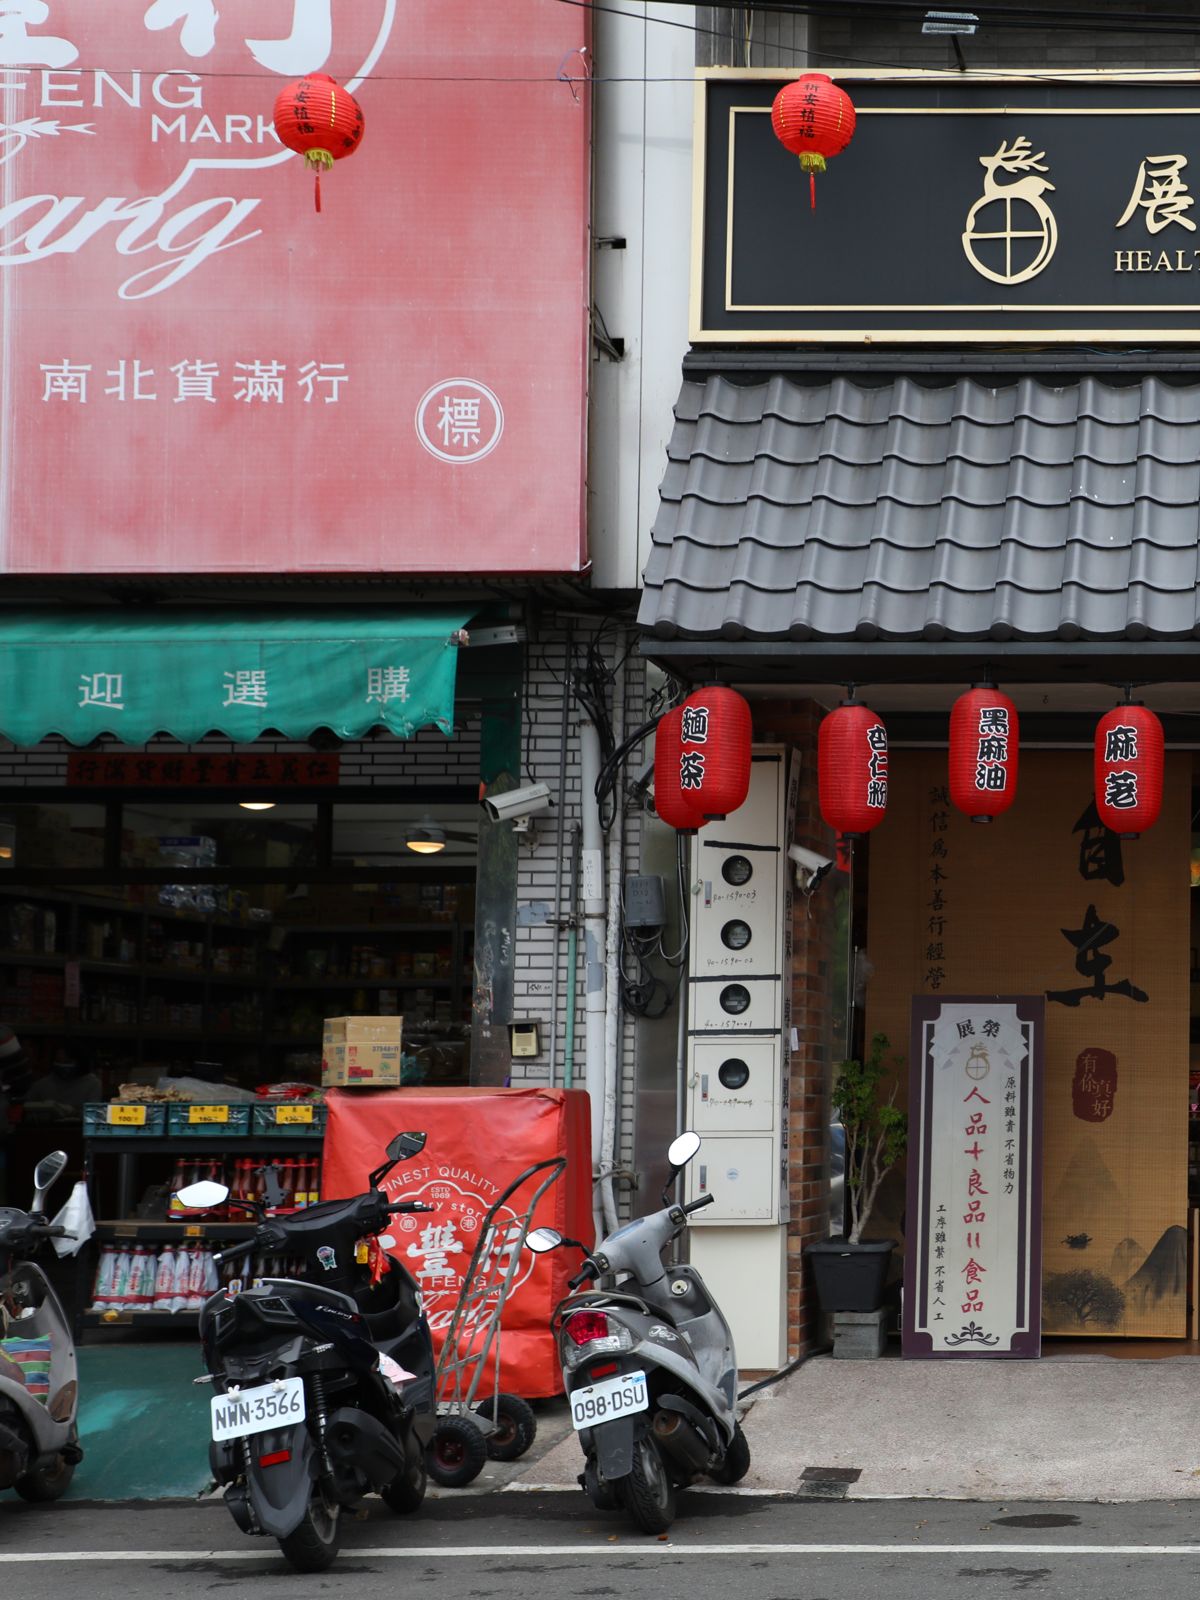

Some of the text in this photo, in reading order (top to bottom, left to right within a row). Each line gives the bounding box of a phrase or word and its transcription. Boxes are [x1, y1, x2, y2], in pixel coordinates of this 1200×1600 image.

[40, 358, 350, 403] 南北貨滿行
[437, 396, 482, 447] 標
[680, 706, 708, 790] 麵茶
[975, 708, 1009, 791] 黑麻油
[438, 1166, 500, 1196] QUALITY
